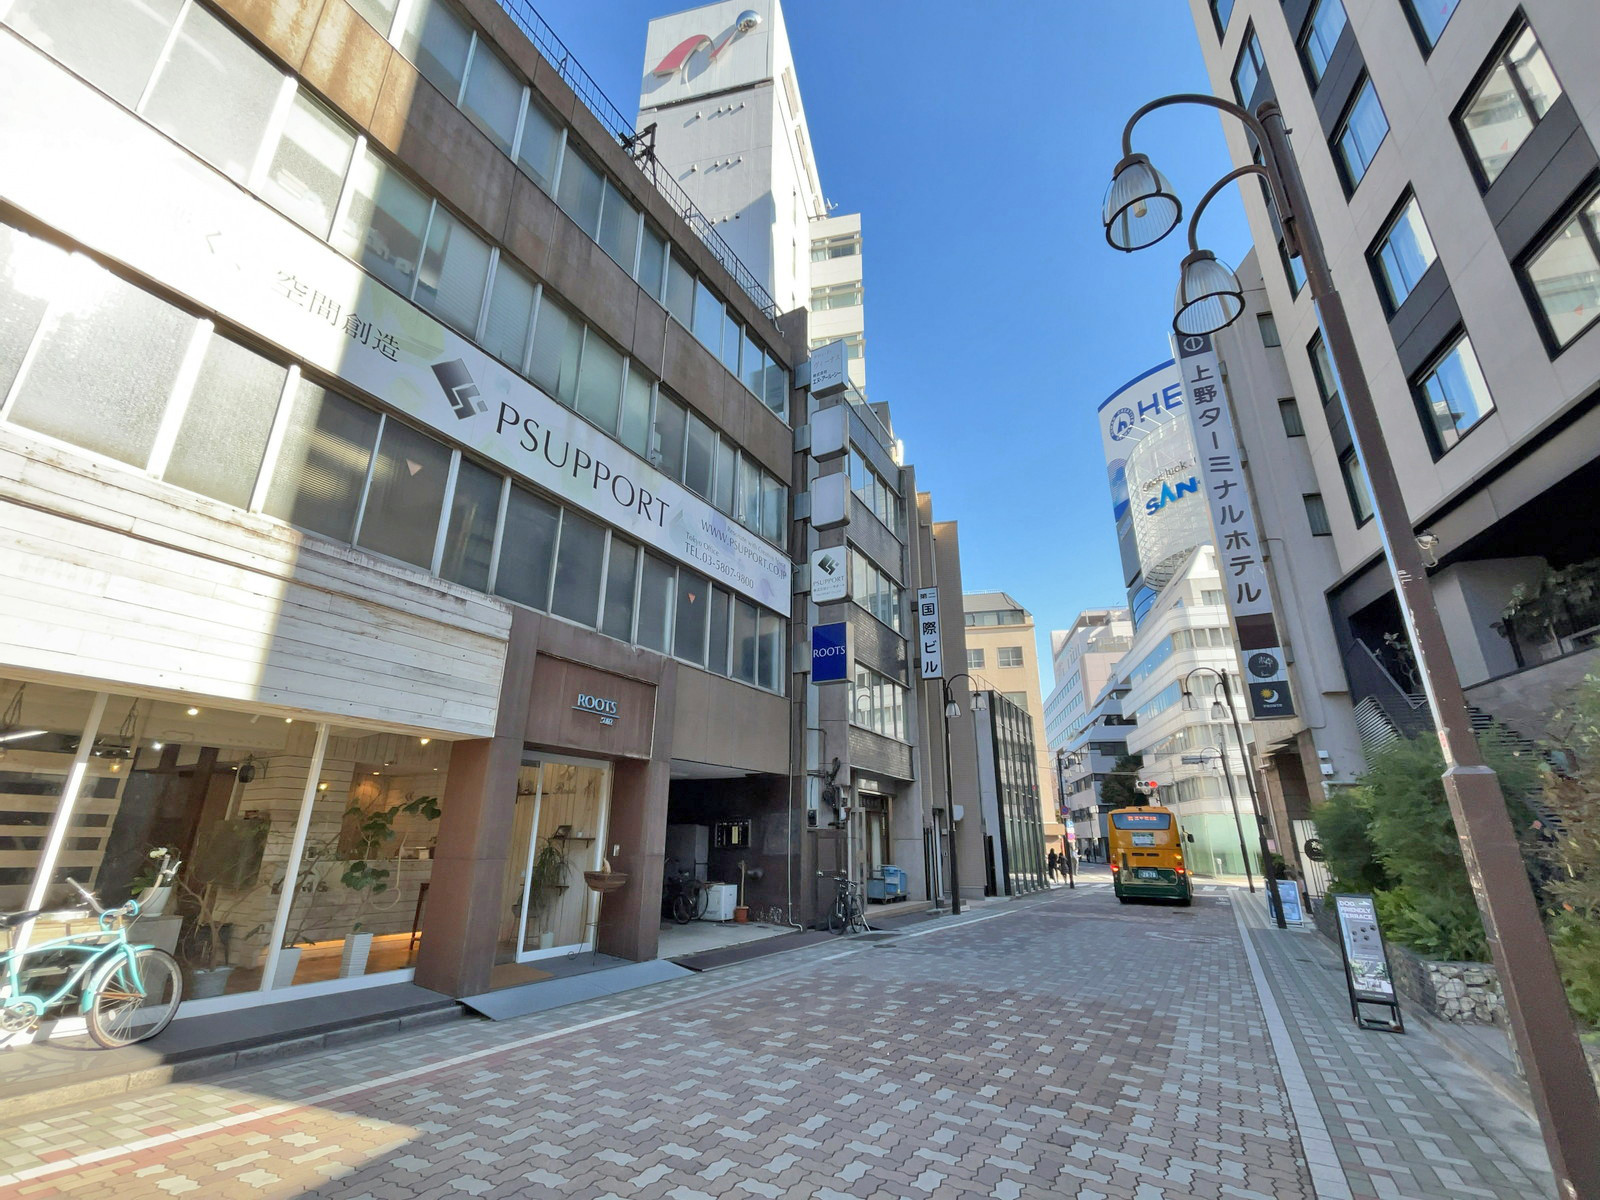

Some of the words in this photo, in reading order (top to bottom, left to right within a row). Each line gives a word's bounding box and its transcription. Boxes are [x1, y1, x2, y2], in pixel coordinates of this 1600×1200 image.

[1137, 382, 1183, 423] HE
[495, 400, 671, 528] PSUPPORT
[1190, 364, 1262, 604] 上野ターミナルホテル
[813, 645, 846, 659] ROOTS
[922, 602, 938, 673] 国際ビル
[577, 693, 618, 714] ROOTS
